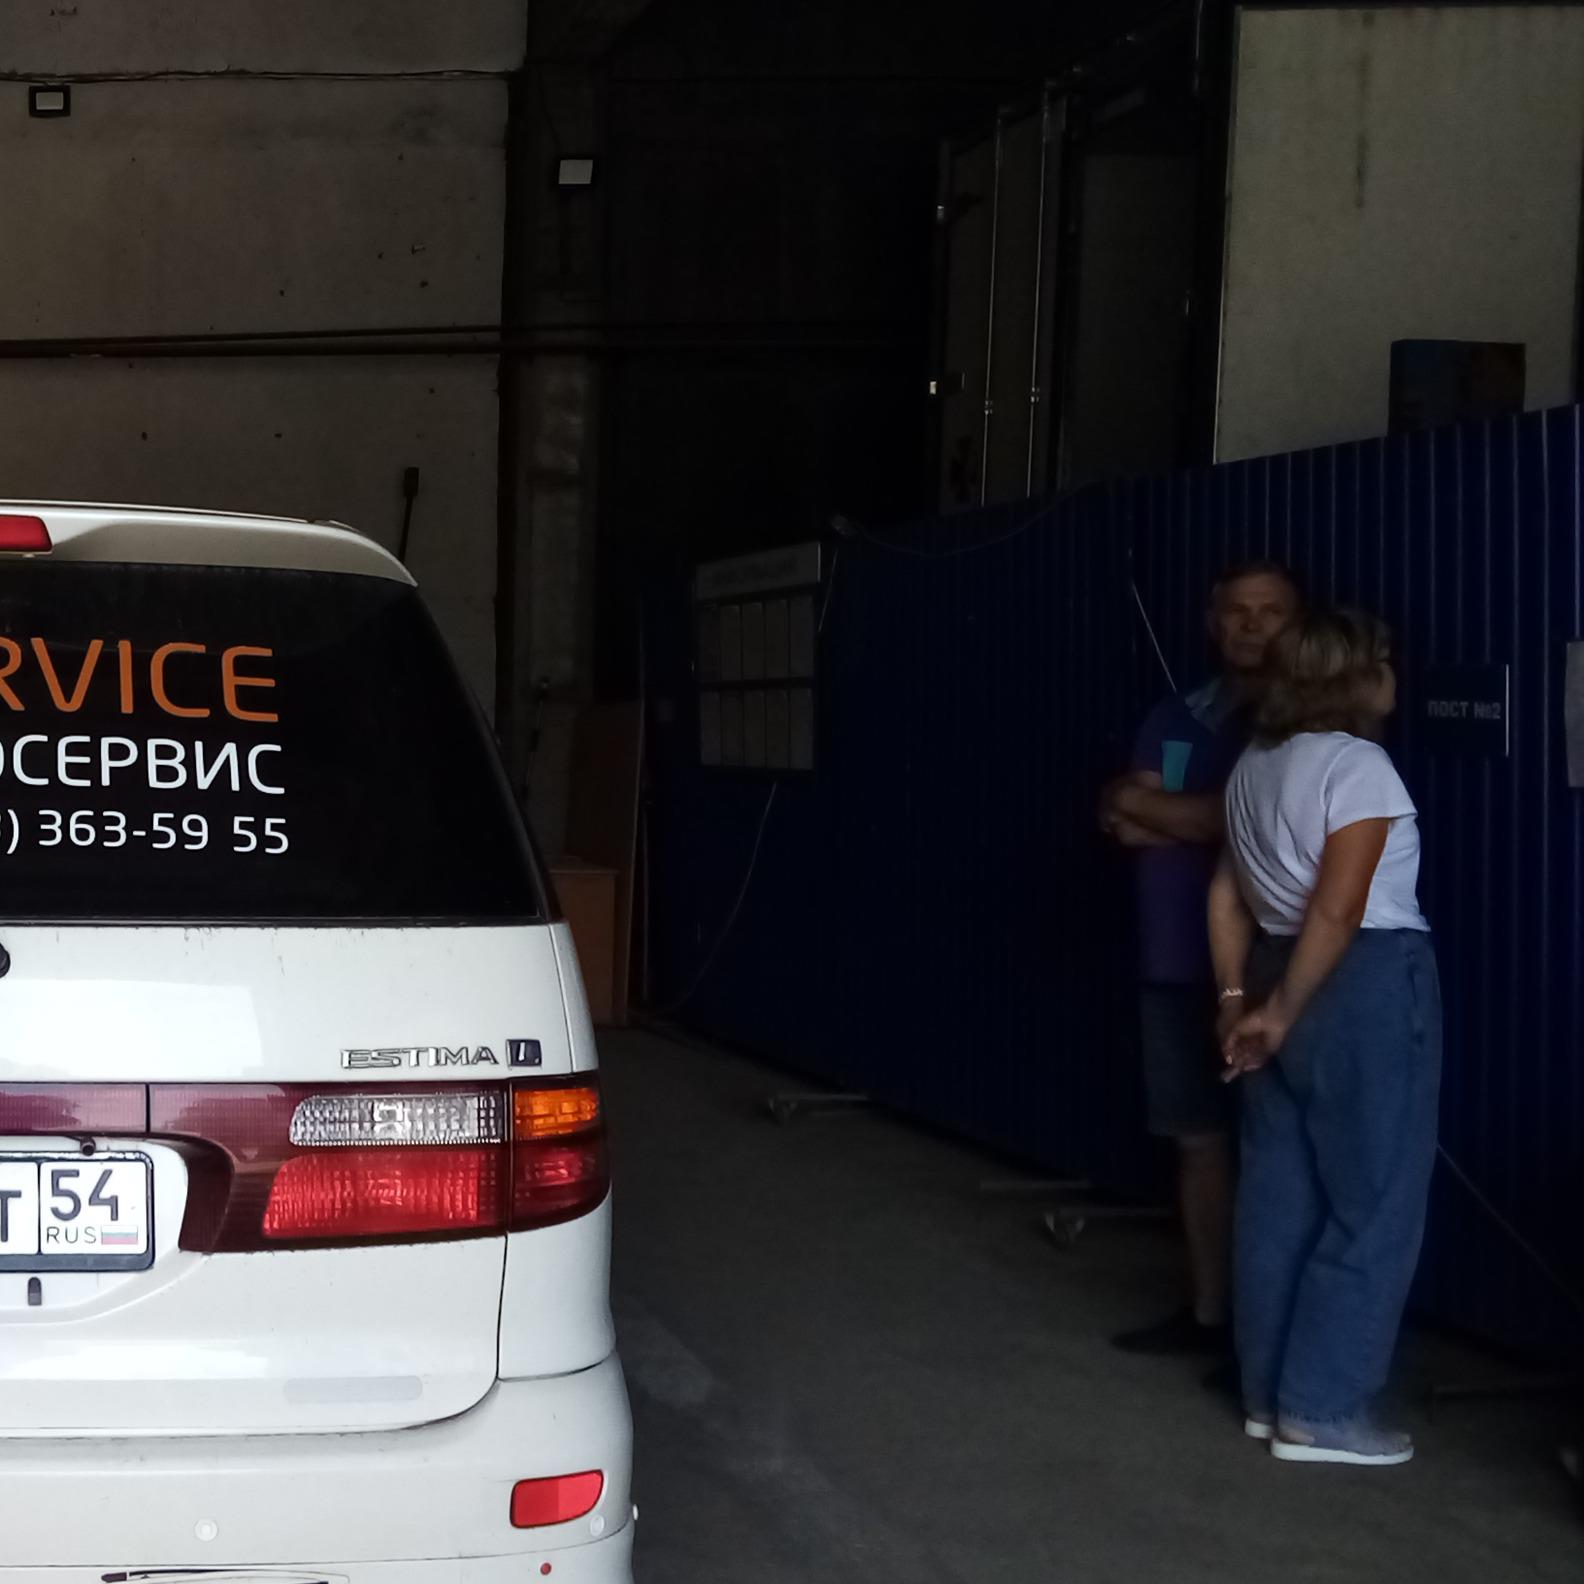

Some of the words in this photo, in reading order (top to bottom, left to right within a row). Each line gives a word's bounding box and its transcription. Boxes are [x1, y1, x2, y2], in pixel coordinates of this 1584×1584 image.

[1426, 701, 1469, 718] ПОСТ
[38, 809, 209, 850] 363-59
[233, 815, 289, 854] 55
[339, 1045, 499, 1069] ESTIMA
[49, 1169, 119, 1222] 54
[46, 1226, 97, 1245] RUS
